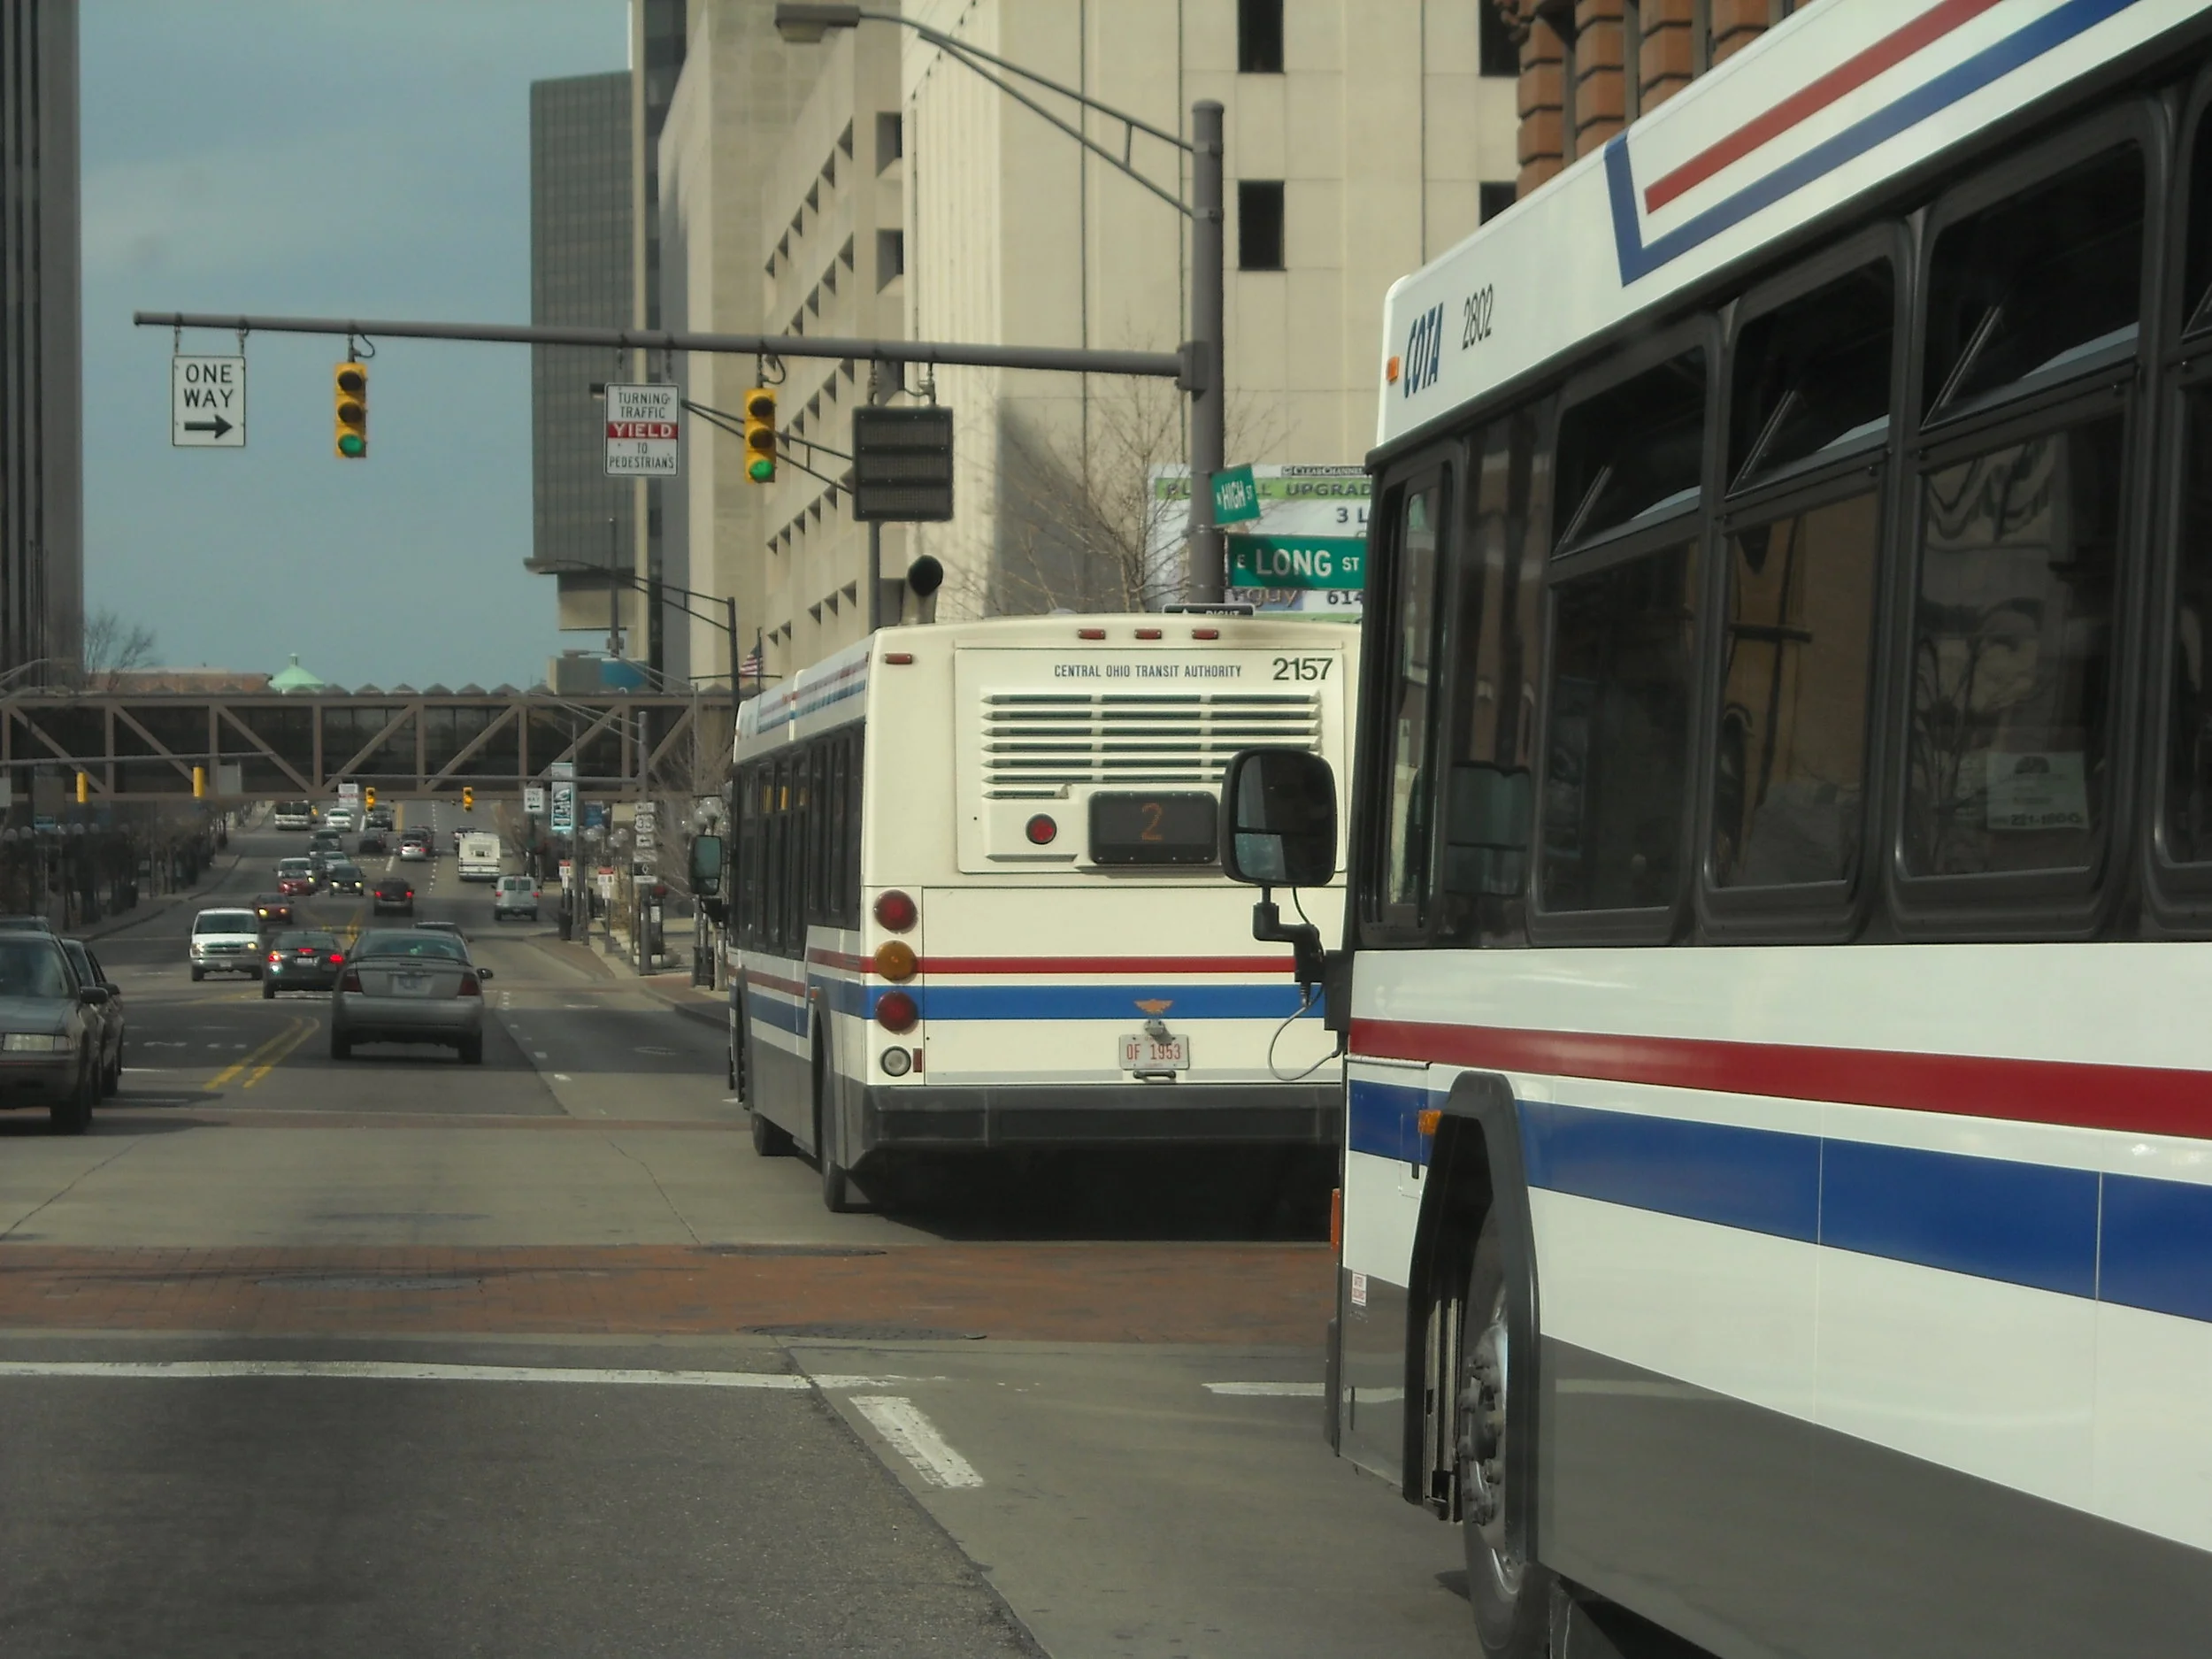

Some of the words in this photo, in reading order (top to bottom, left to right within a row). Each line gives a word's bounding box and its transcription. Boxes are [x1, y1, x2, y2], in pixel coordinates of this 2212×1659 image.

[1403, 301, 1444, 398] COTA
[1462, 283, 1494, 349] 2802
[186, 364, 233, 383] ONE
[184, 388, 234, 408] WAY
[618, 392, 671, 405] TURNING
[620, 406, 666, 419] TRAFFIC
[612, 423, 672, 438] YIELD
[637, 442, 648, 454] TO
[609, 456, 674, 469] PEDESTRIANS
[1221, 480, 1246, 511] HIGH
[1245, 484, 1253, 501] ST
[1336, 507, 1348, 524] 3
[1237, 554, 1246, 568] E
[1256, 549, 1332, 577] LONG
[1341, 557, 1360, 571] ST
[1055, 664, 1102, 678] CENTRAL
[1106, 664, 1130, 678] OHIO
[1135, 664, 1179, 678] TRANSIT
[1184, 664, 1241, 678] AUTHORITY
[1272, 657, 1333, 680] 2157
[1141, 803, 1164, 841] 2
[1126, 1043, 1141, 1061] OF
[1149, 1043, 1181, 1061] 1953
